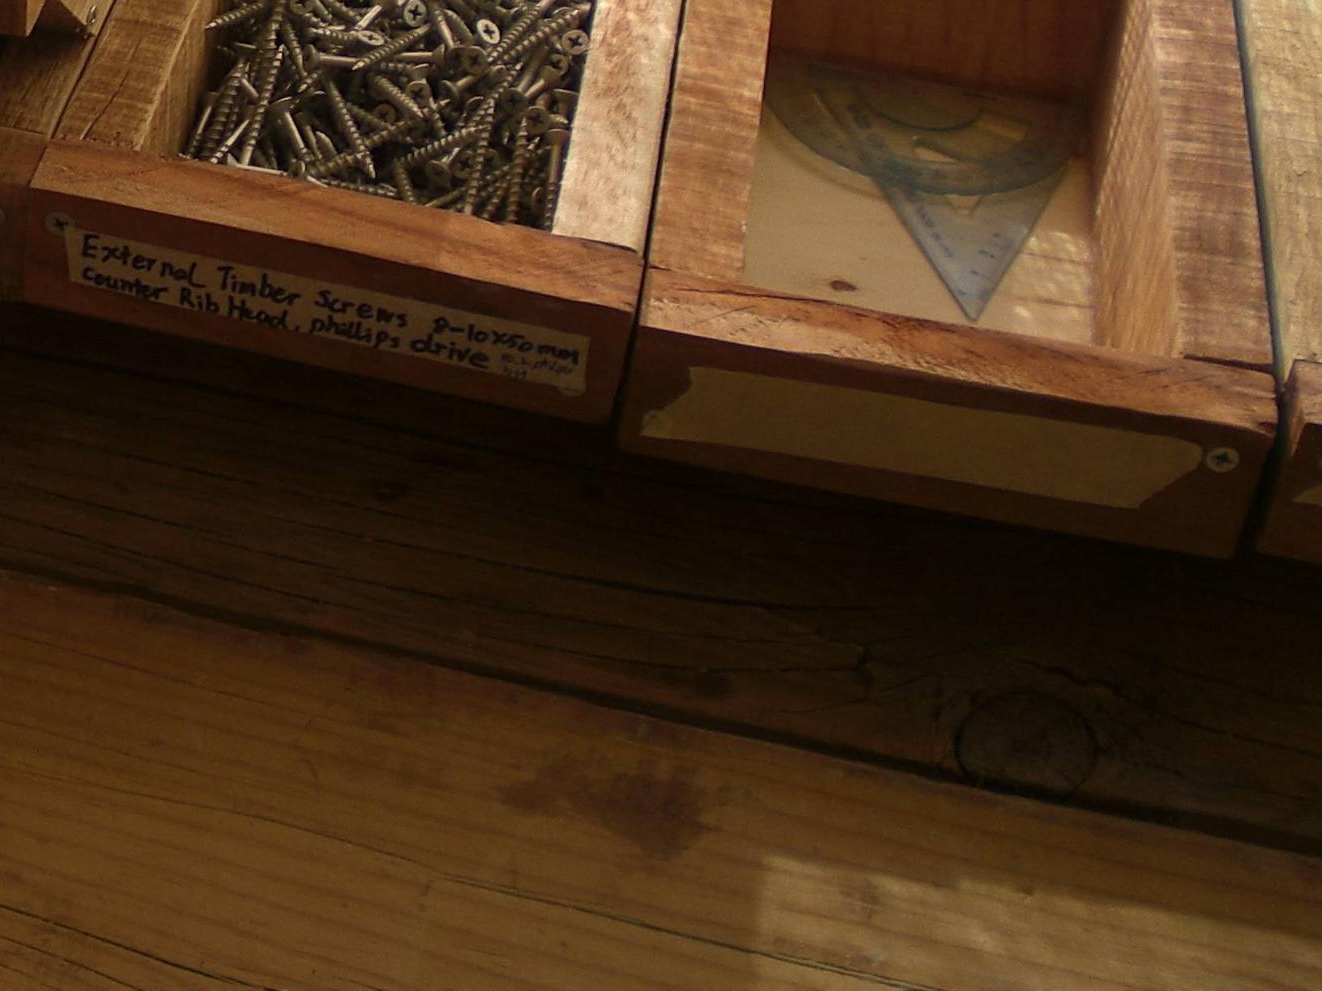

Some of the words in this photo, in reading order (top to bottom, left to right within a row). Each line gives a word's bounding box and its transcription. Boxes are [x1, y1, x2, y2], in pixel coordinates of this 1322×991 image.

[81, 233, 207, 289] External
[216, 265, 302, 306] Timber
[313, 289, 407, 328] Screws
[179, 287, 220, 314] Rib
[410, 335, 492, 370] drive
